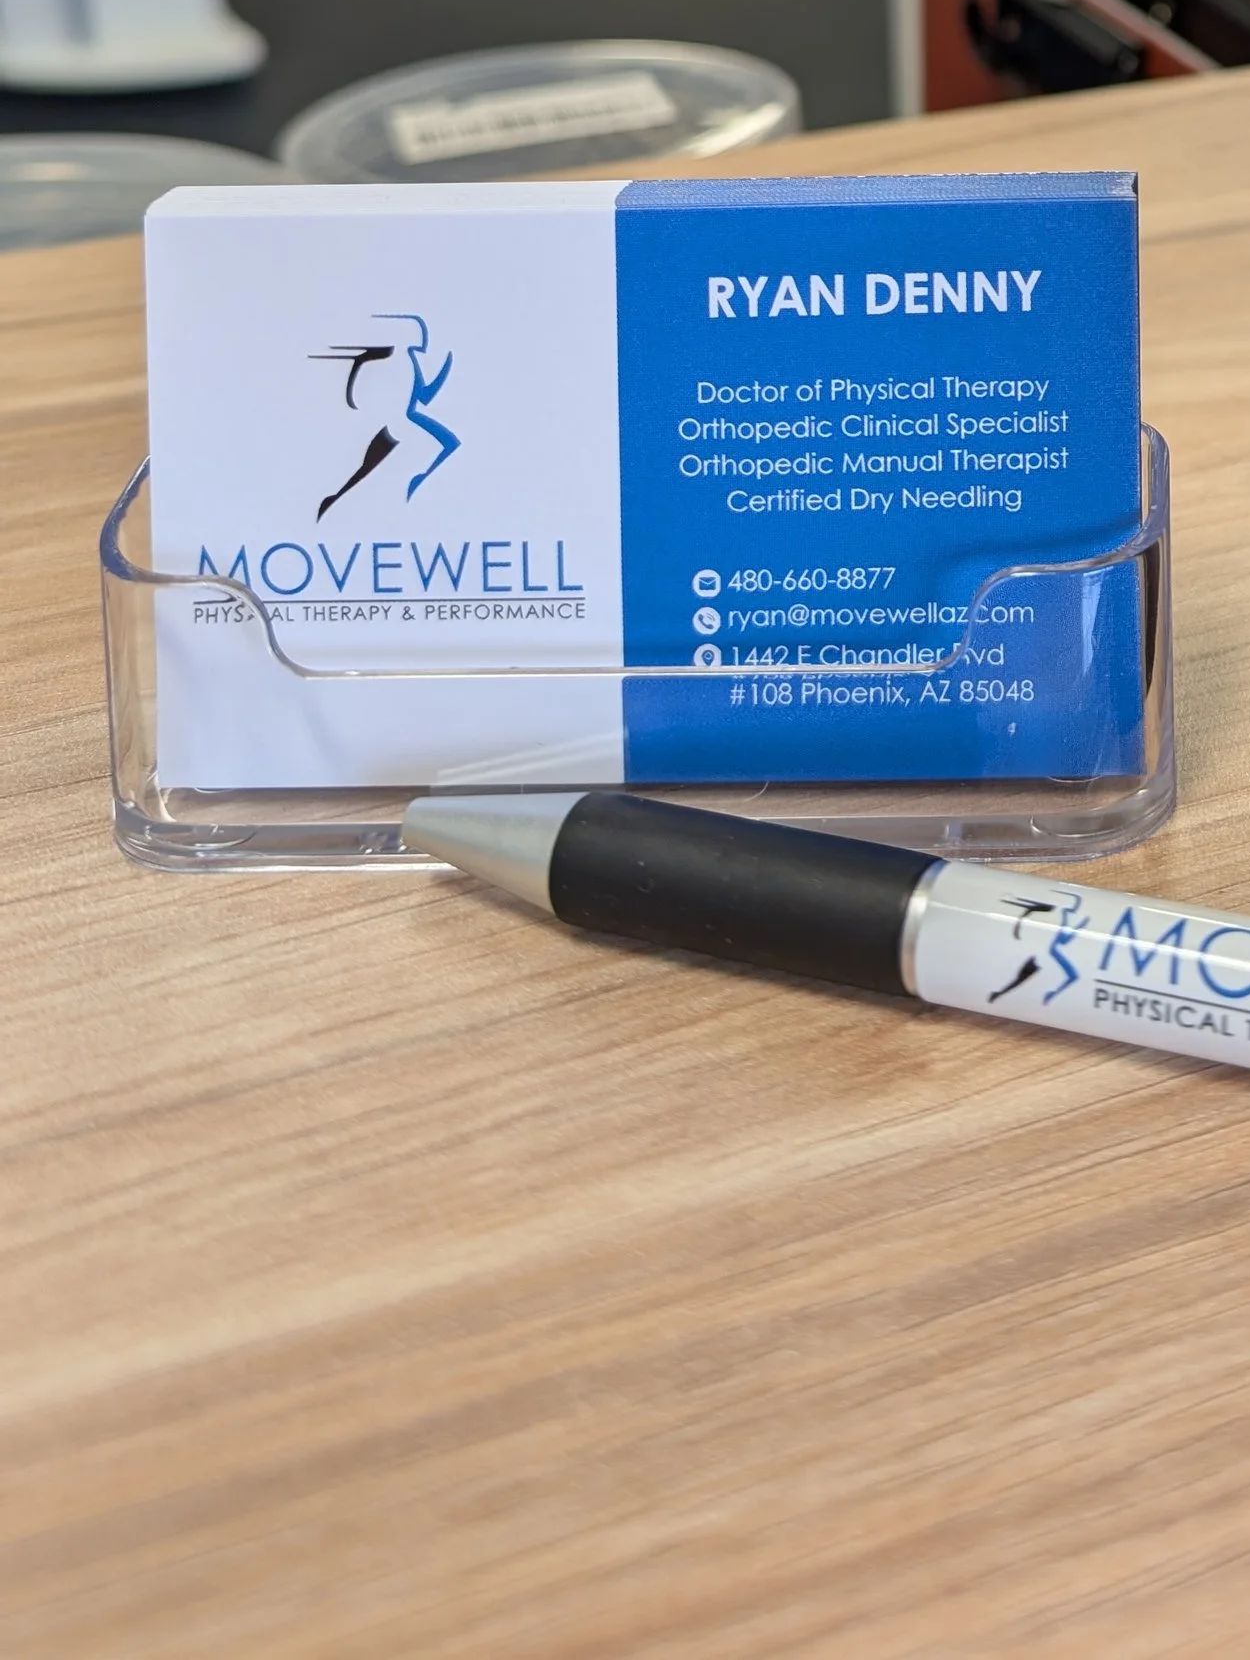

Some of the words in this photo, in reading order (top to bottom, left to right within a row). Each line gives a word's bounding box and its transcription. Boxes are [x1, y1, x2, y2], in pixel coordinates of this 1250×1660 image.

[708, 274, 845, 318] RYAN
[865, 270, 1042, 315] DENNY
[697, 381, 789, 404] Doctor
[796, 380, 823, 402] of
[830, 377, 934, 405] Physical
[942, 376, 1050, 402] Therapy
[678, 416, 833, 444] Orthopedic
[841, 414, 939, 438] Clinical
[945, 410, 1069, 439] Specialist
[679, 452, 833, 479] Orthopedic
[842, 450, 942, 474] Manual
[950, 447, 1069, 475] Therapist
[727, 488, 842, 513] Certified
[850, 488, 894, 514] Dry
[902, 485, 1022, 512] Needling
[198, 541, 584, 595] MOVEWELL
[727, 567, 897, 591] 480-660-8877
[194, 601, 295, 624] PHYSAL
[303, 605, 392, 622] THERAPY
[402, 605, 416, 621] &
[425, 602, 586, 621] PERFORMANCE
[728, 601, 1034, 632] ryan@movewellazcom
[732, 645, 789, 665] 1442
[797, 645, 812, 665] E
[819, 643, 945, 665] Chandler
[730, 683, 793, 706] #108
[801, 680, 910, 707] Phoenix,
[920, 680, 951, 703] AZ
[959, 680, 1034, 702] 85048
[1093, 988, 1234, 1037] PHYSICAL
